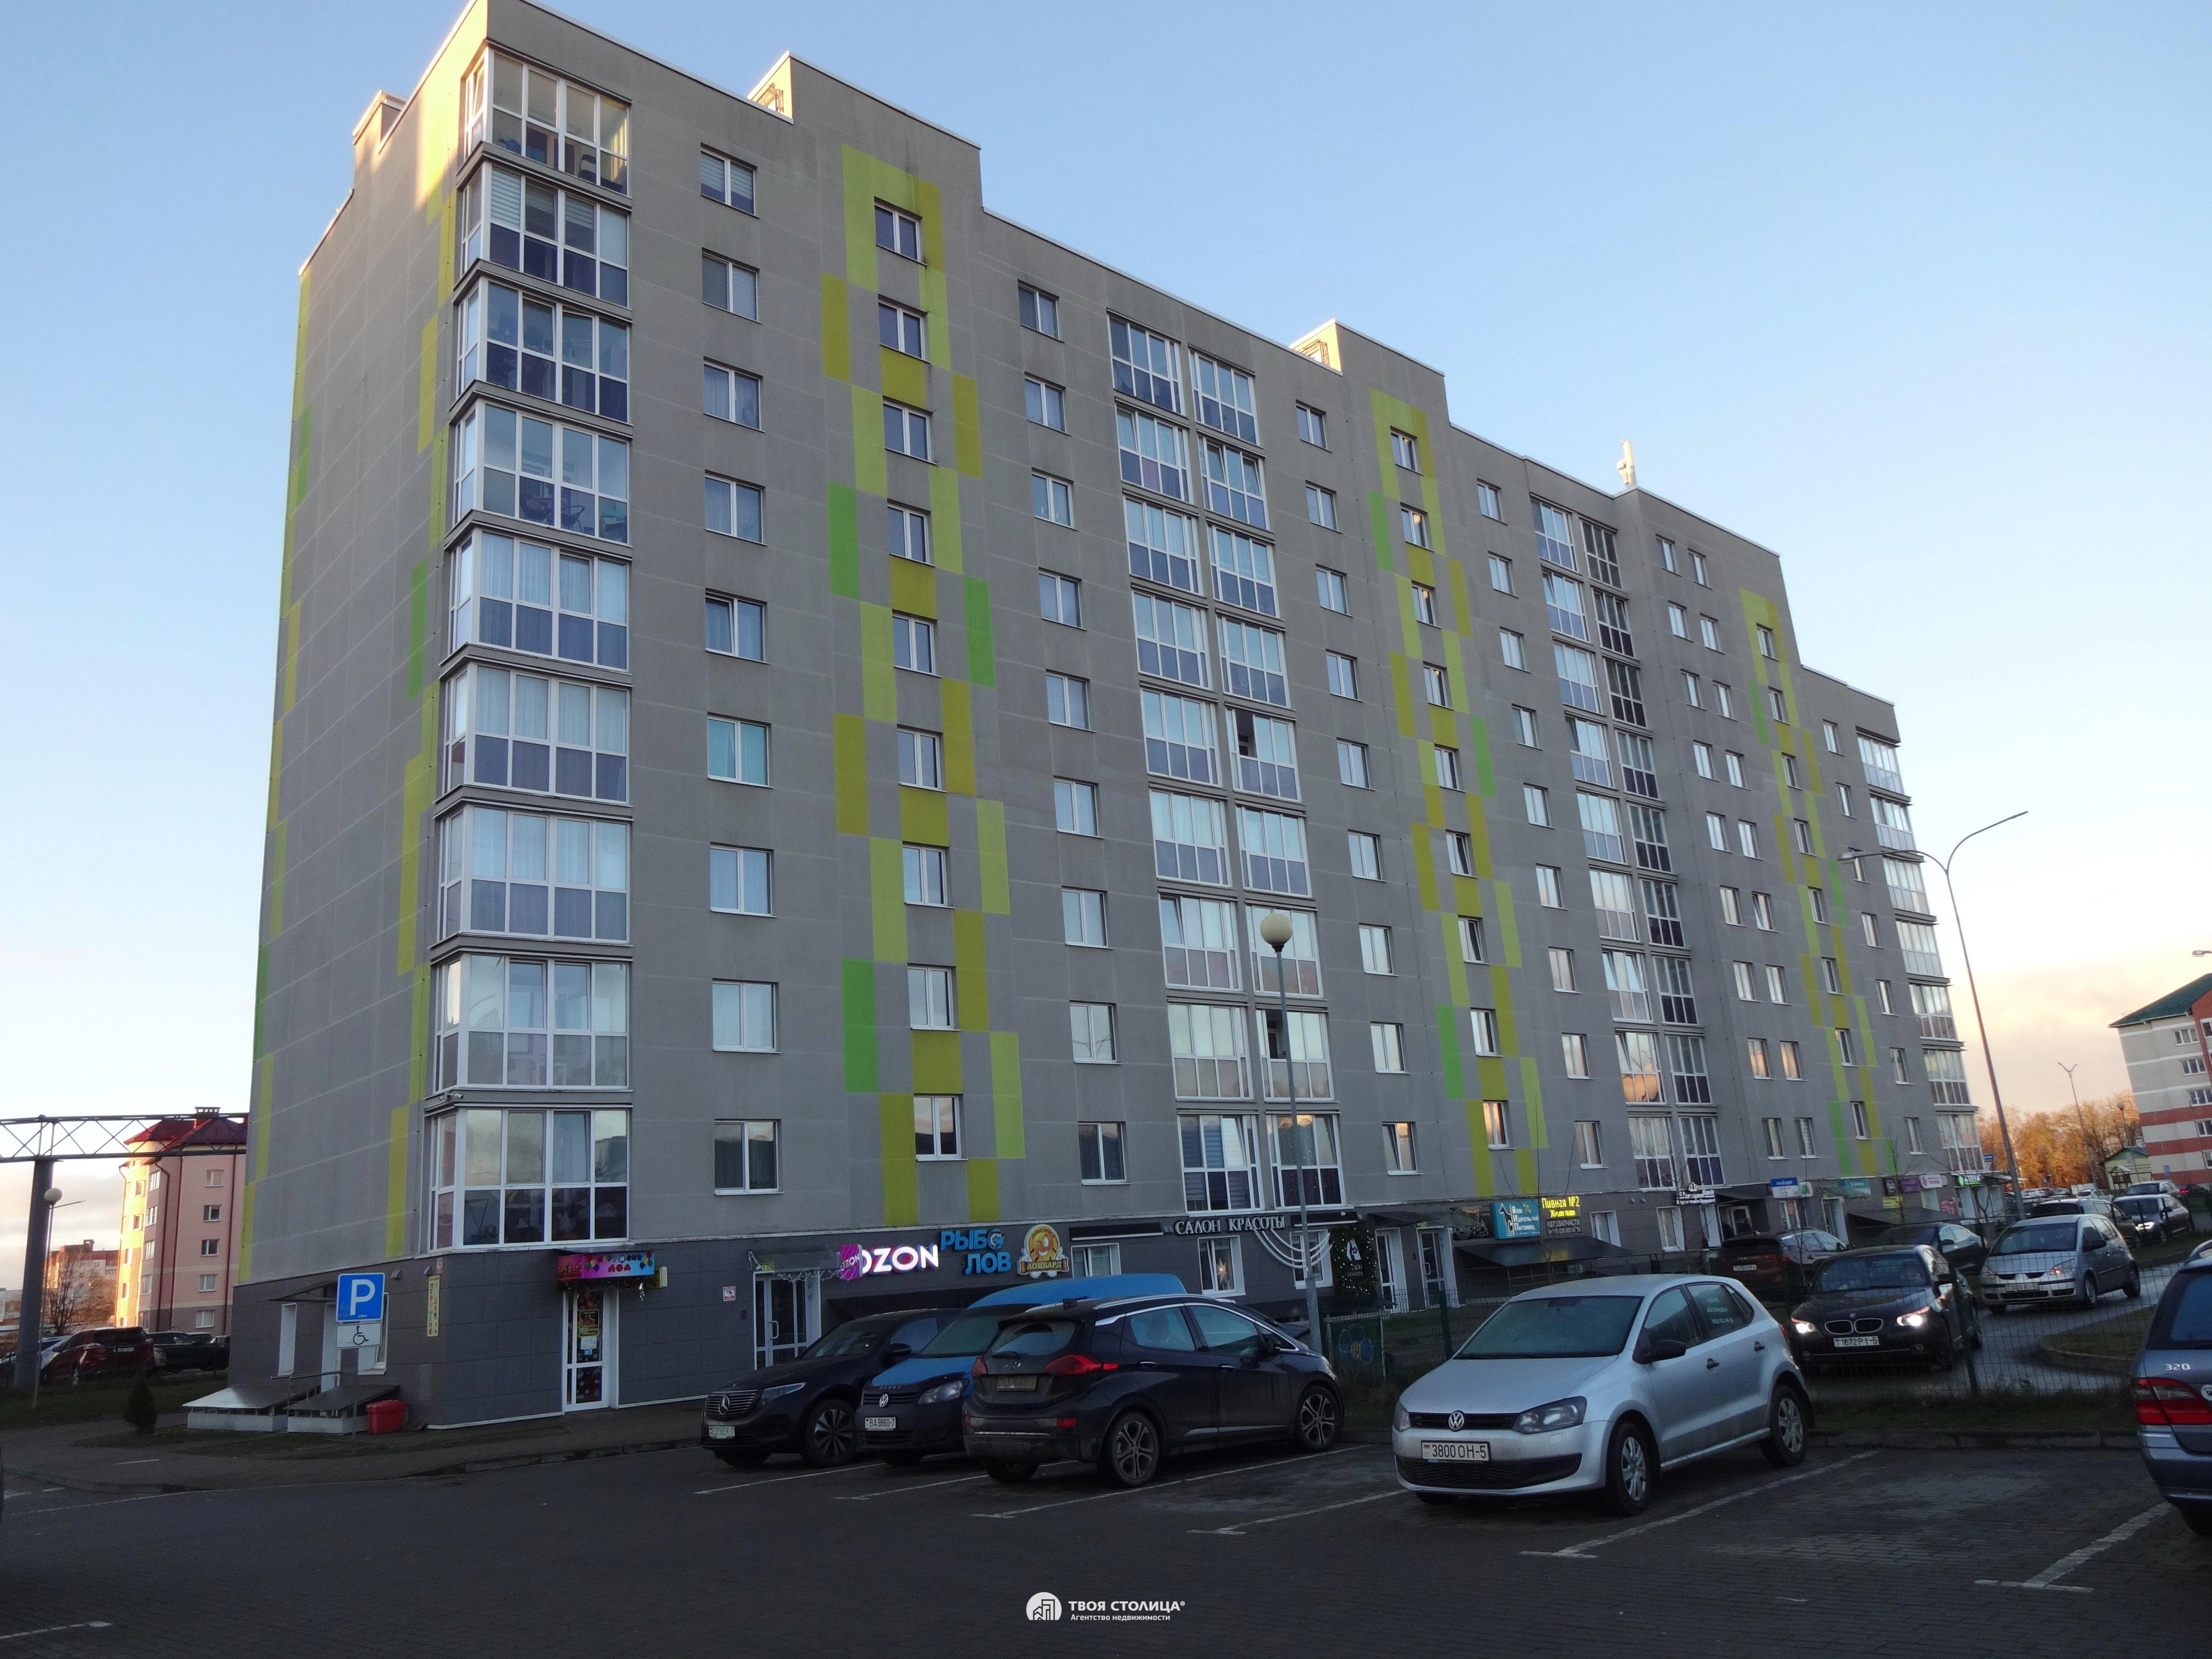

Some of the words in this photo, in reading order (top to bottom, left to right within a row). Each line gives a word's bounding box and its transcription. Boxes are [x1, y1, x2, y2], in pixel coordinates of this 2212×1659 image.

[1542, 1198, 1566, 1209] Пивная
[1175, 1220, 1221, 1235] САЛОН
[1228, 1216, 1284, 1231] КРАСОТЫ
[965, 1252, 1011, 1275] ЛОВ
[1026, 1261, 1062, 1270] ЛОМБАРД
[350, 1279, 375, 1316] P
